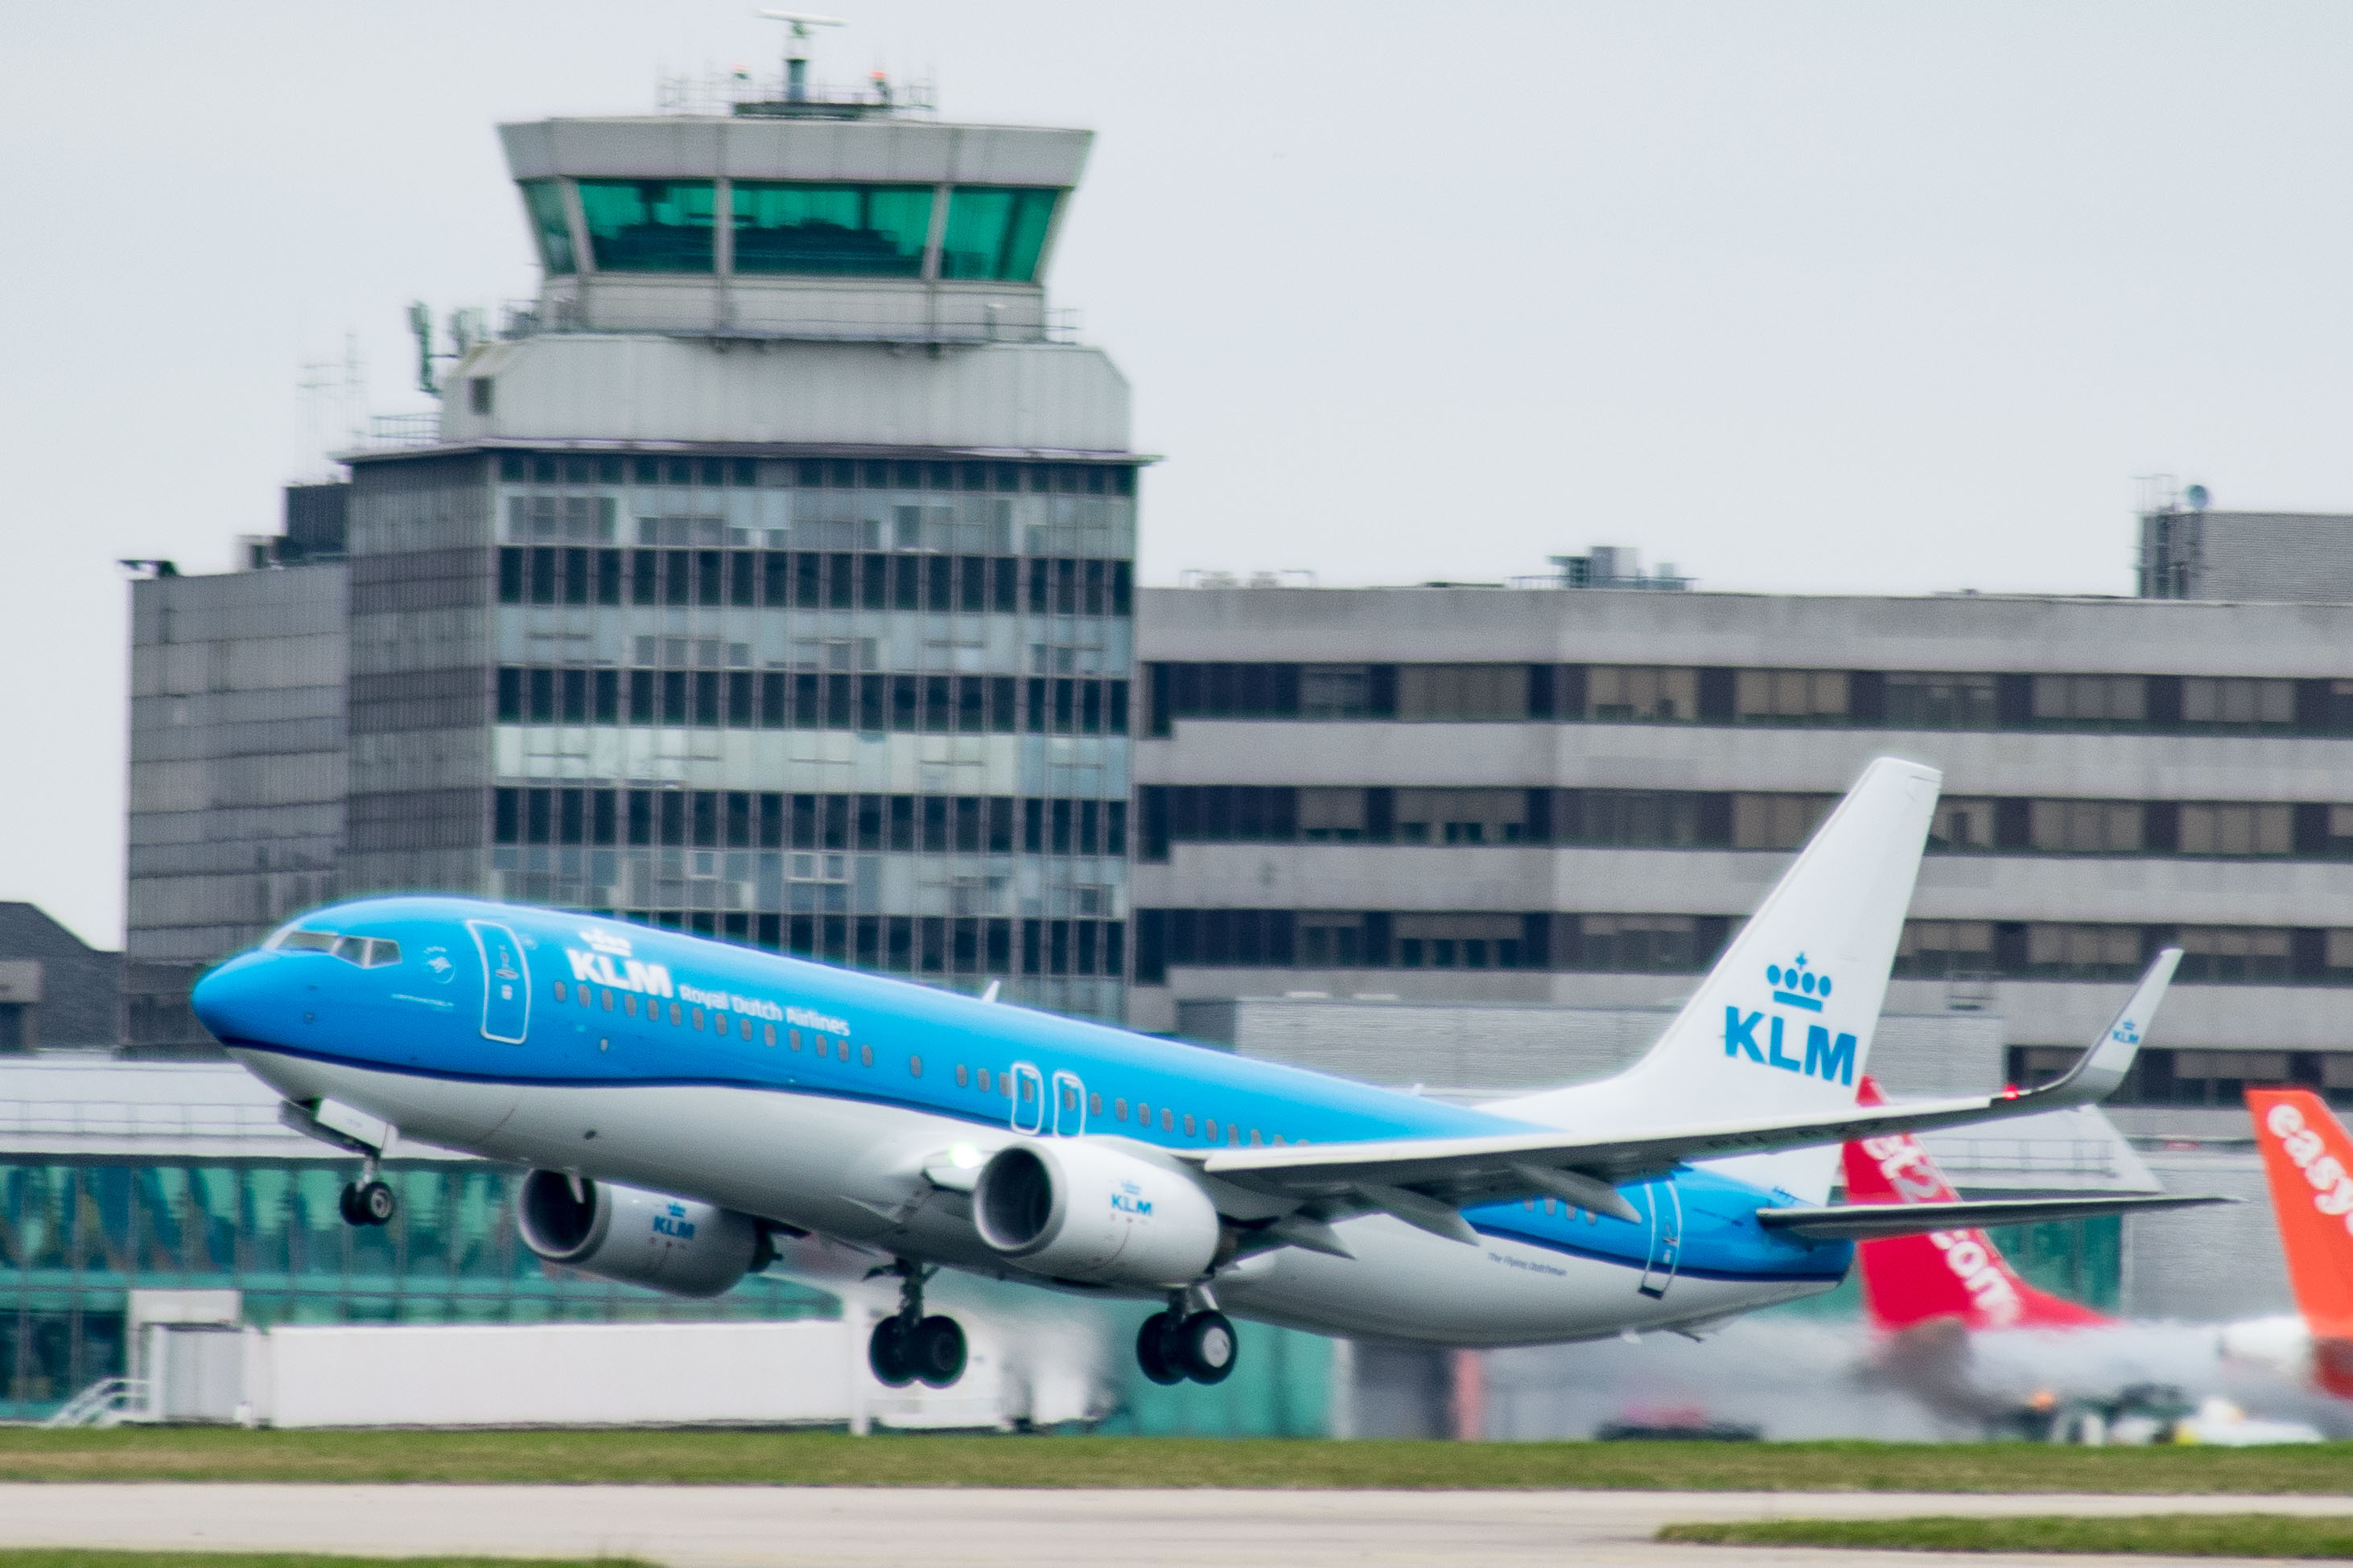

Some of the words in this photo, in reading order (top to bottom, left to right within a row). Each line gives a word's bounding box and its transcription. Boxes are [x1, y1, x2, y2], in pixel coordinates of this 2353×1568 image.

[567, 949, 674, 998] KLM
[679, 985, 730, 1010] Royal
[730, 994, 784, 1022] Dutch
[786, 1006, 851, 1036] Airlines
[1725, 1005, 1856, 1086] KLM
[2112, 1030, 2140, 1044] KLM
[2267, 1103, 2353, 1237] easy
[653, 1216, 695, 1240] KLM
[1111, 1194, 1152, 1217] KLM
